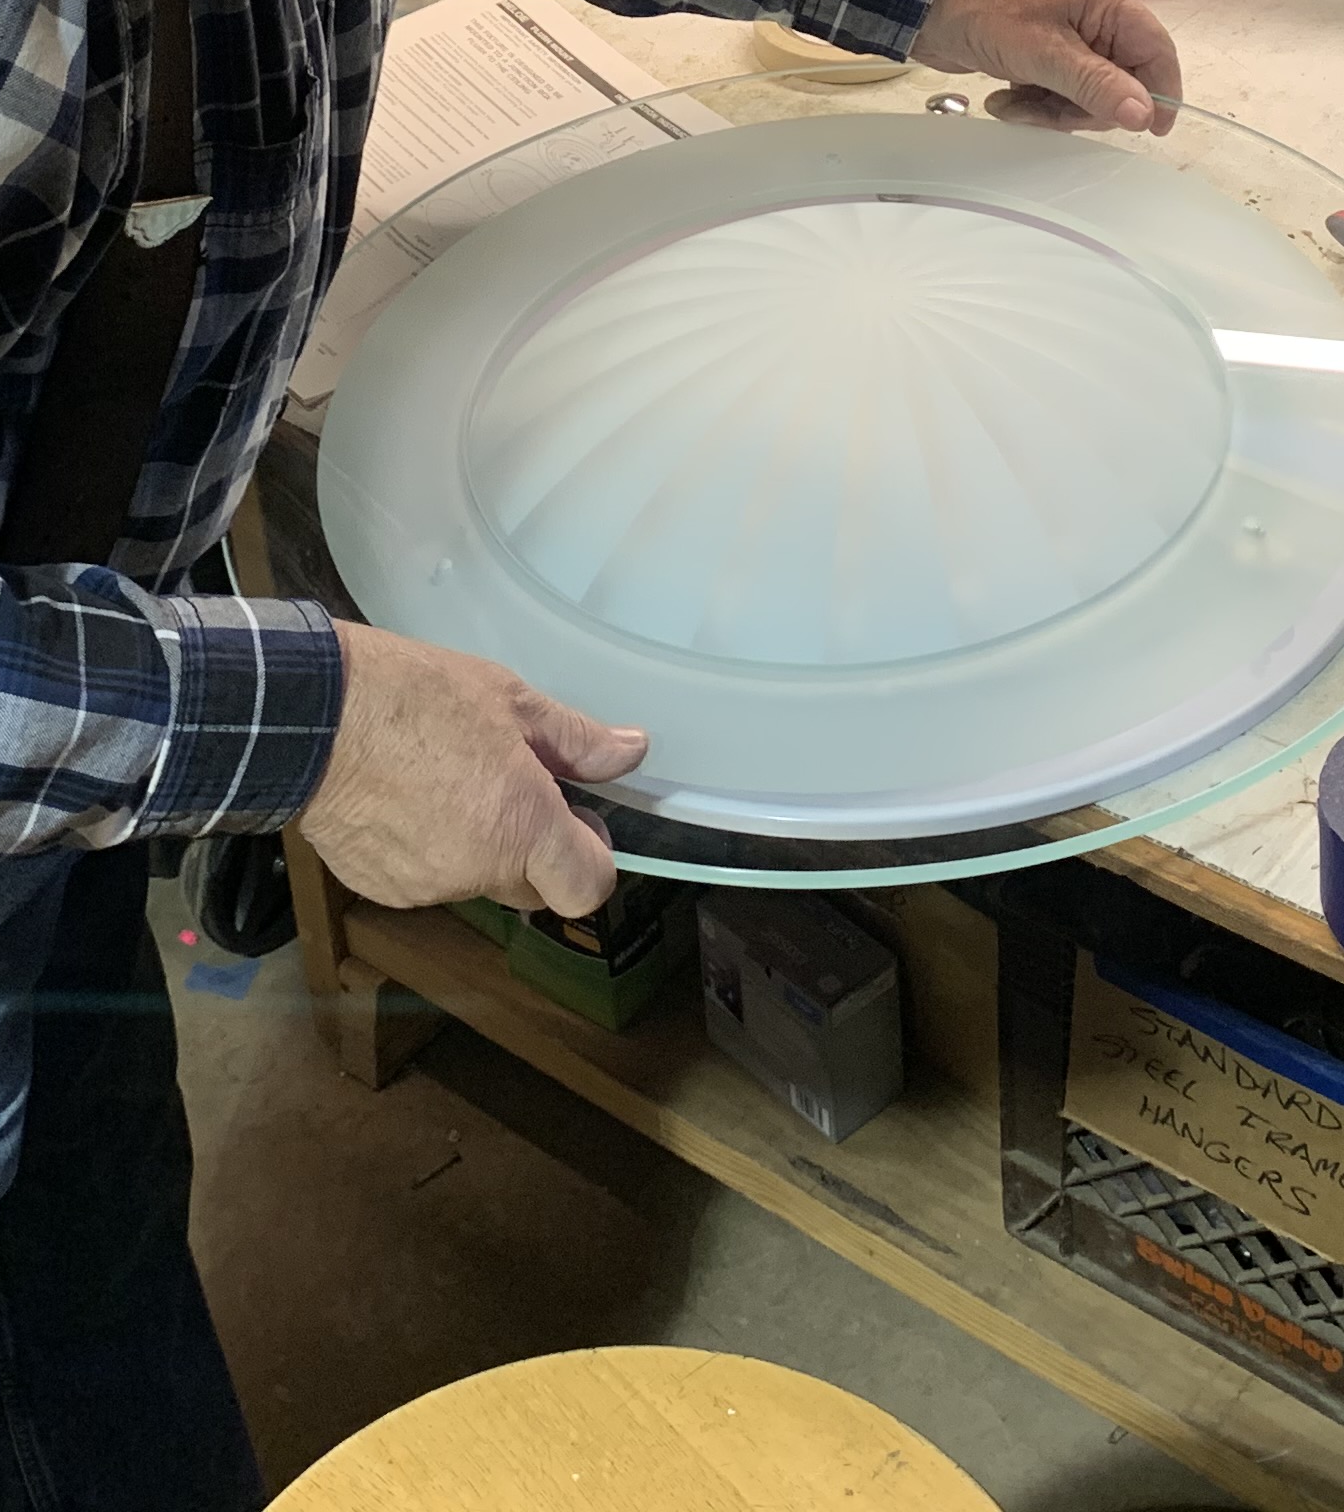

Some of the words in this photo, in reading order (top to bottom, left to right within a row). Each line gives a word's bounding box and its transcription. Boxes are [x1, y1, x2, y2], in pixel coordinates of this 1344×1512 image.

[1093, 1033, 1199, 1102] STEEL
[1130, 1006, 1343, 1131] STANDARD
[1139, 1095, 1317, 1217] HANGERS
